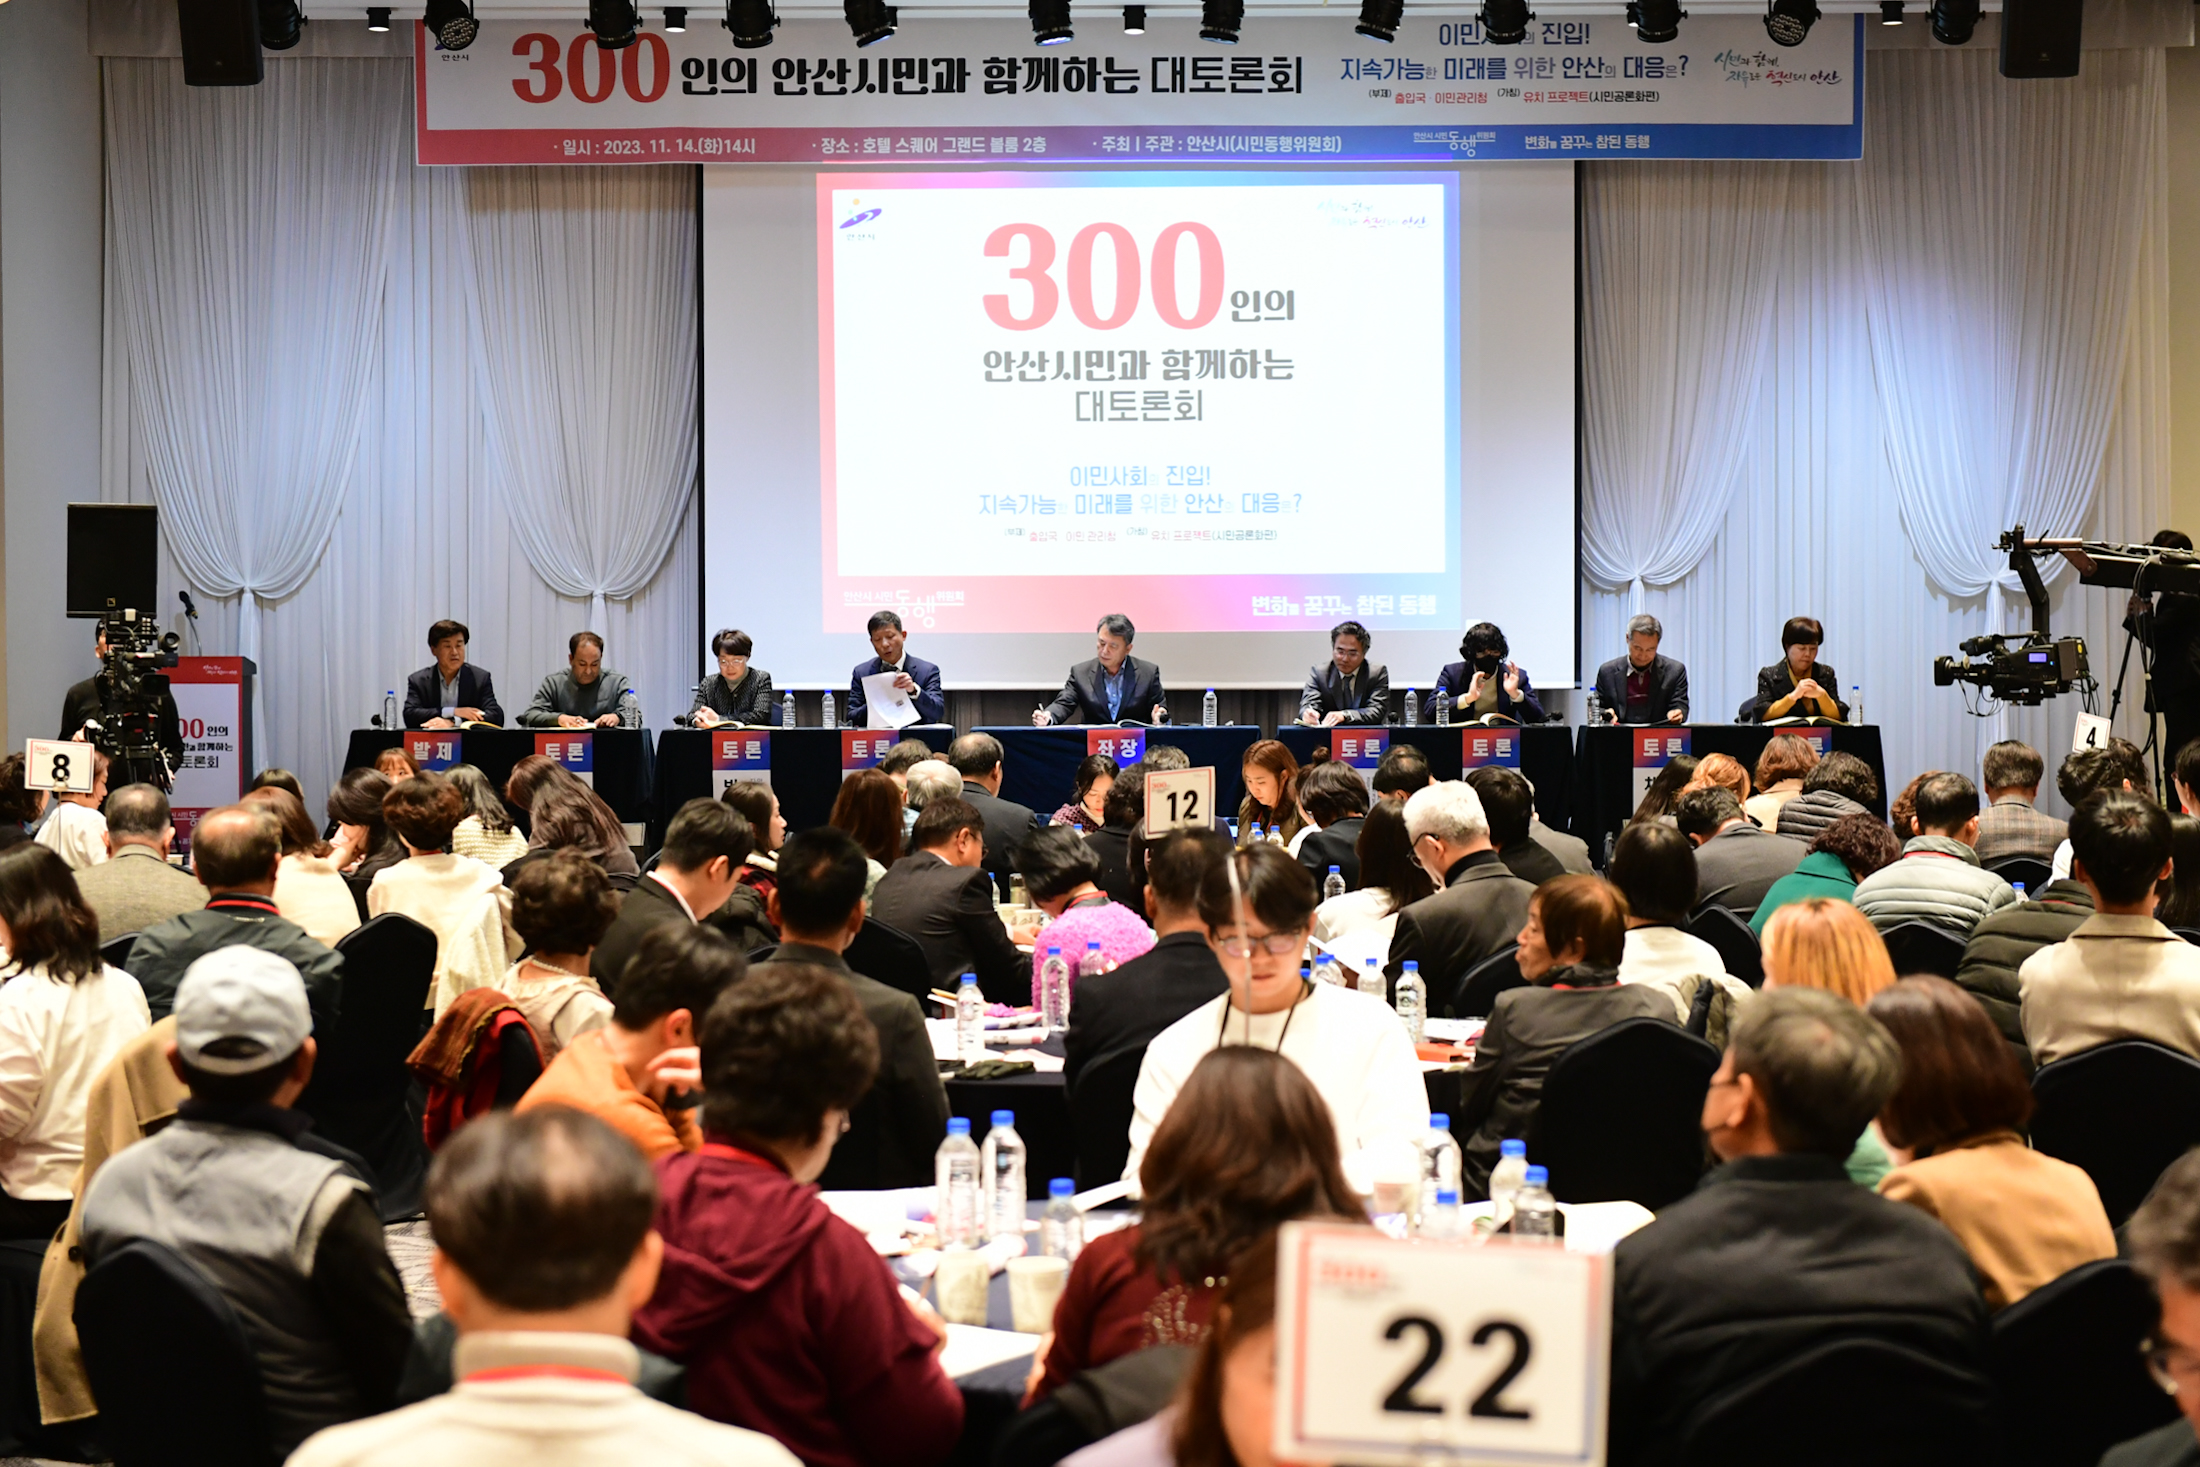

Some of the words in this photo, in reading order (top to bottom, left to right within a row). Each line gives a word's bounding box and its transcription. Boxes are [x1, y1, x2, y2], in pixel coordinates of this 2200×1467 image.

[1541, 22, 1590, 45] 진입!
[441, 54, 470, 62] 안산시
[512, 32, 670, 104] 300
[681, 57, 757, 96] 인의
[772, 57, 971, 96] 안산시민과
[983, 56, 1140, 95] 함께하는
[1151, 56, 1303, 95] 대토론회
[1341, 57, 1438, 81] 지속가능한
[1444, 57, 1507, 80] 미래를
[1513, 56, 1556, 80] 위한
[1562, 56, 1617, 79] 안산의
[1623, 55, 1689, 79] 대응은?
[1810, 69, 1843, 85] 안산
[1368, 88, 1392, 98] (부제)
[1394, 92, 1427, 104] 출입국
[1434, 92, 1488, 104] 이민관리청
[1497, 88, 1520, 98] (가칭)
[1523, 91, 1545, 103] 유치
[820, 137, 850, 154] 장소
[862, 137, 891, 154] 호텔
[895, 136, 938, 154] 스퀘어
[942, 136, 986, 153] 그랜드
[1022, 135, 1047, 153] 2층
[1101, 135, 1131, 152] 주최
[1145, 135, 1175, 152] 주관
[1186, 135, 1342, 153] 안산시(시민동행위원회)
[1413, 132, 1434, 140] 안산시
[1434, 131, 1448, 140] 시민
[1476, 131, 1497, 140] 위원회
[1560, 135, 1593, 149] 꿈꾸는
[1596, 134, 1621, 149] 참된
[1624, 134, 1651, 149] 동행
[562, 140, 591, 156] 일시
[603, 140, 645, 155] 2023.
[649, 139, 671, 154] 11.
[982, 221, 1225, 331] 300
[1229, 289, 1296, 323] 인의
[982, 348, 1151, 383] 안산시민과
[1160, 347, 1296, 382] 함께하는
[1074, 389, 1204, 423] 대토론회
[1165, 465, 1211, 487] 진입!
[1074, 493, 1133, 515] 미래를
[1139, 493, 1178, 515] 위한
[1184, 493, 1235, 515] 안산의
[1151, 530, 1170, 542] 유치
[843, 590, 872, 602] 안산시
[874, 590, 893, 602] 시민
[935, 590, 965, 602] 위원회
[1251, 595, 1300, 617] 변화를
[1303, 595, 1353, 616] 꿈꾸는
[1356, 594, 1394, 616] 참된
[1398, 594, 1437, 616] 동행
[207, 725, 229, 737] 인의
[2086, 726, 2097, 748] 4
[51, 753, 71, 782] 8
[1166, 789, 1199, 821] 12
[1380, 1315, 1534, 1421] 22
